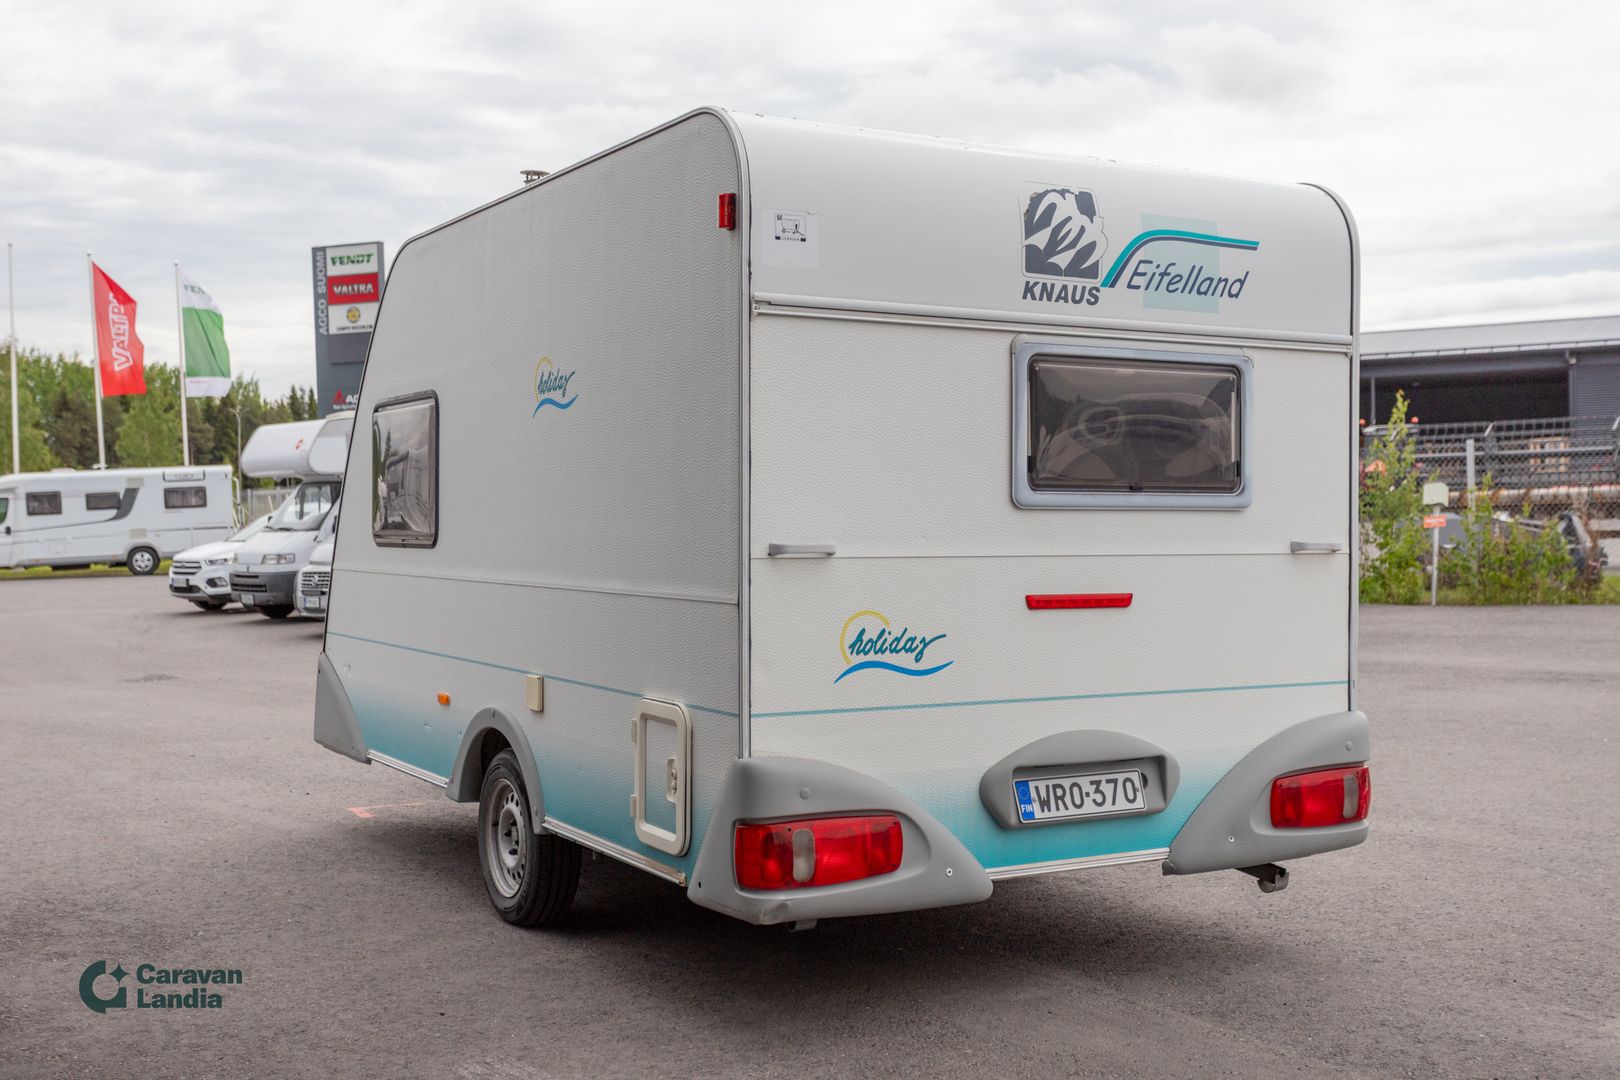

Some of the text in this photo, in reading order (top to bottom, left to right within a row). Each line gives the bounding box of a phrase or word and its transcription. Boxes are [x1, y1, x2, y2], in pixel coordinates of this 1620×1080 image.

[330, 253, 374, 266] FENDT
[316, 252, 327, 335] AGCO SUOMI
[333, 283, 374, 295] VALTRA
[1022, 280, 1101, 306] KNAUS
[1126, 259, 1250, 300] Eifelland
[537, 368, 576, 398] holiday
[848, 627, 947, 663] holiday
[1020, 804, 1034, 813] FIN
[1034, 777, 1138, 814] WRO-370
